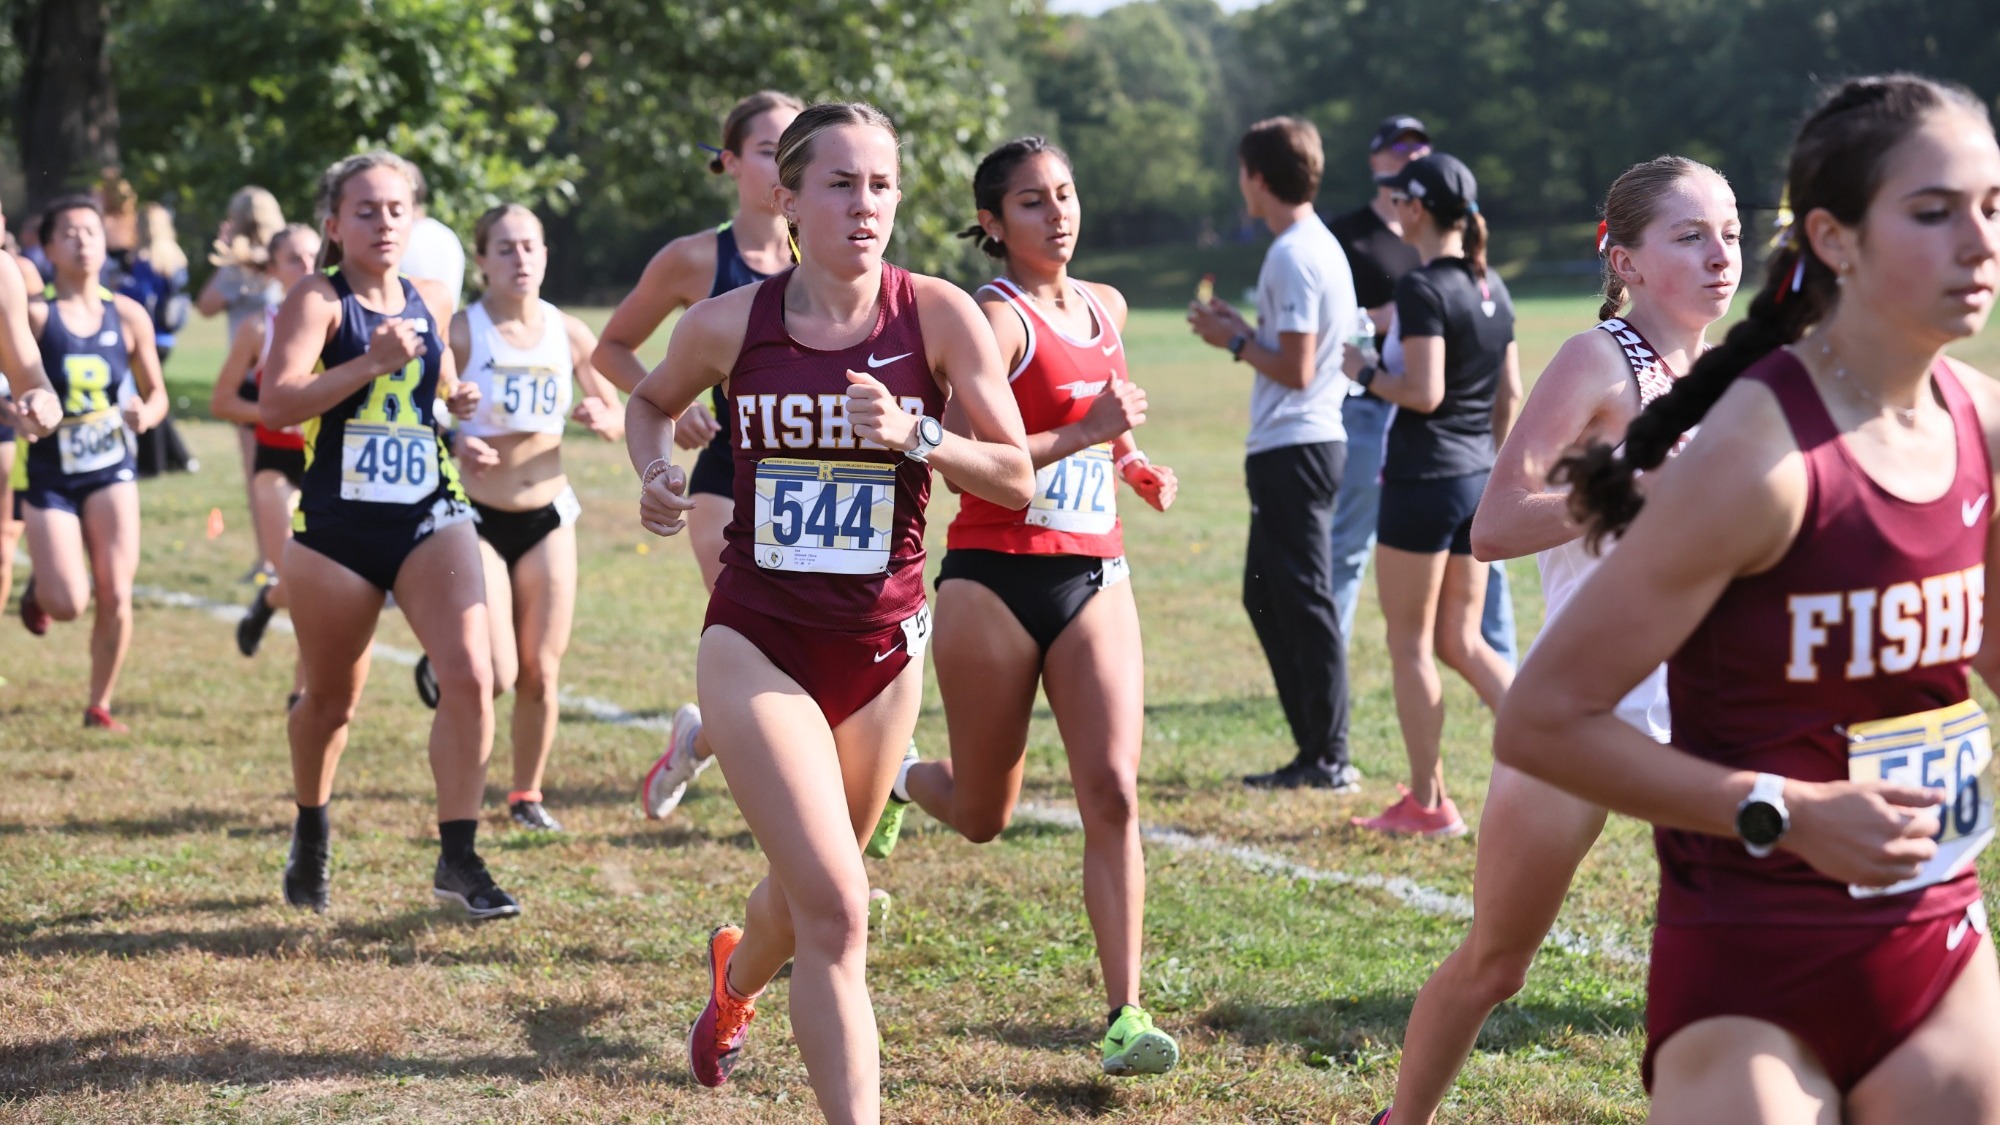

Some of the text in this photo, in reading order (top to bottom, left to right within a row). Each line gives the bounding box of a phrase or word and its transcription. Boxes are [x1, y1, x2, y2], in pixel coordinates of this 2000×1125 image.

[62, 353, 111, 414] R
[356, 357, 425, 425] R
[503, 376, 557, 415] 519
[735, 393, 926, 450] FISH
[355, 436, 426, 486] 496
[817, 462, 835, 482] R
[1045, 458, 1106, 512] 472
[772, 480, 875, 549] 544
